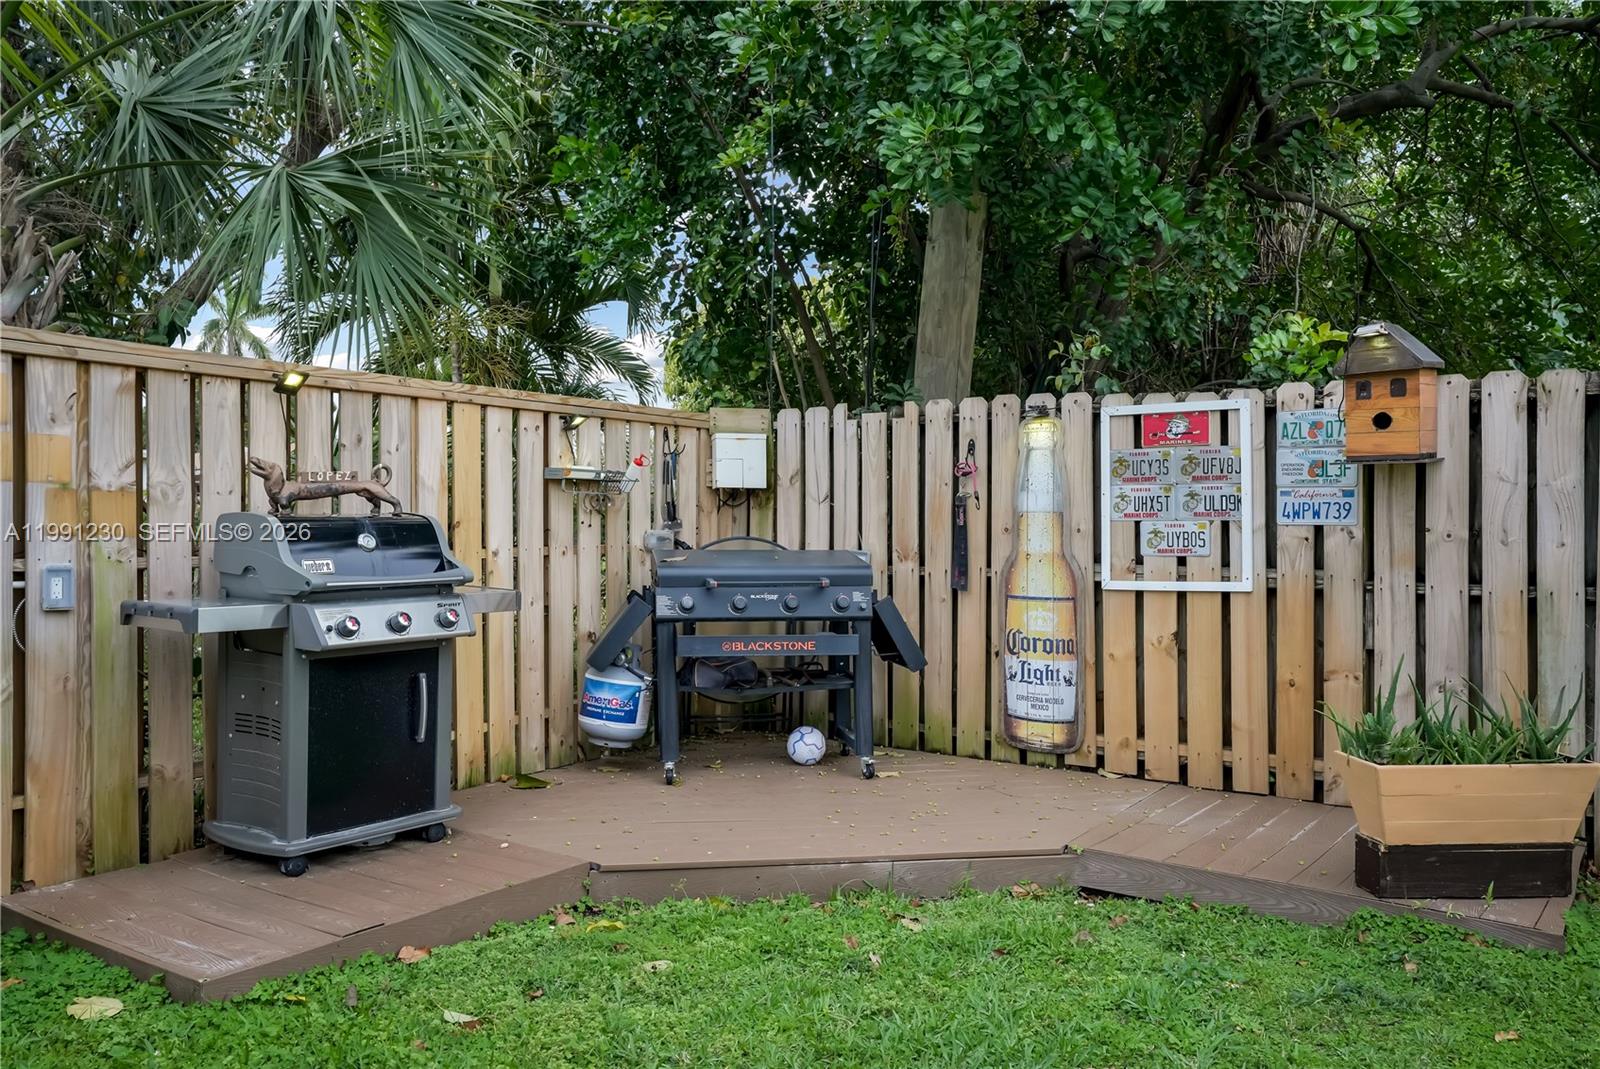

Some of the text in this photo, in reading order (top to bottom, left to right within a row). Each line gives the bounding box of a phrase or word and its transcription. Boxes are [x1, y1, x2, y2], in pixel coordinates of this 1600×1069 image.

[1281, 421, 1307, 440] AZL
[1202, 457, 1242, 474] UFV8J
[308, 471, 352, 482] LOPEZ
[1133, 495, 1171, 512] UHX5T
[1293, 489, 1338, 501] California
[1282, 501, 1352, 520] 4WPW739
[732, 641, 816, 651] BLACKSTONE
[1006, 628, 1076, 659] Corona
[1018, 660, 1061, 686] Light
[583, 692, 633, 709] AmeriGas
[1030, 703, 1050, 711] MEXICO
